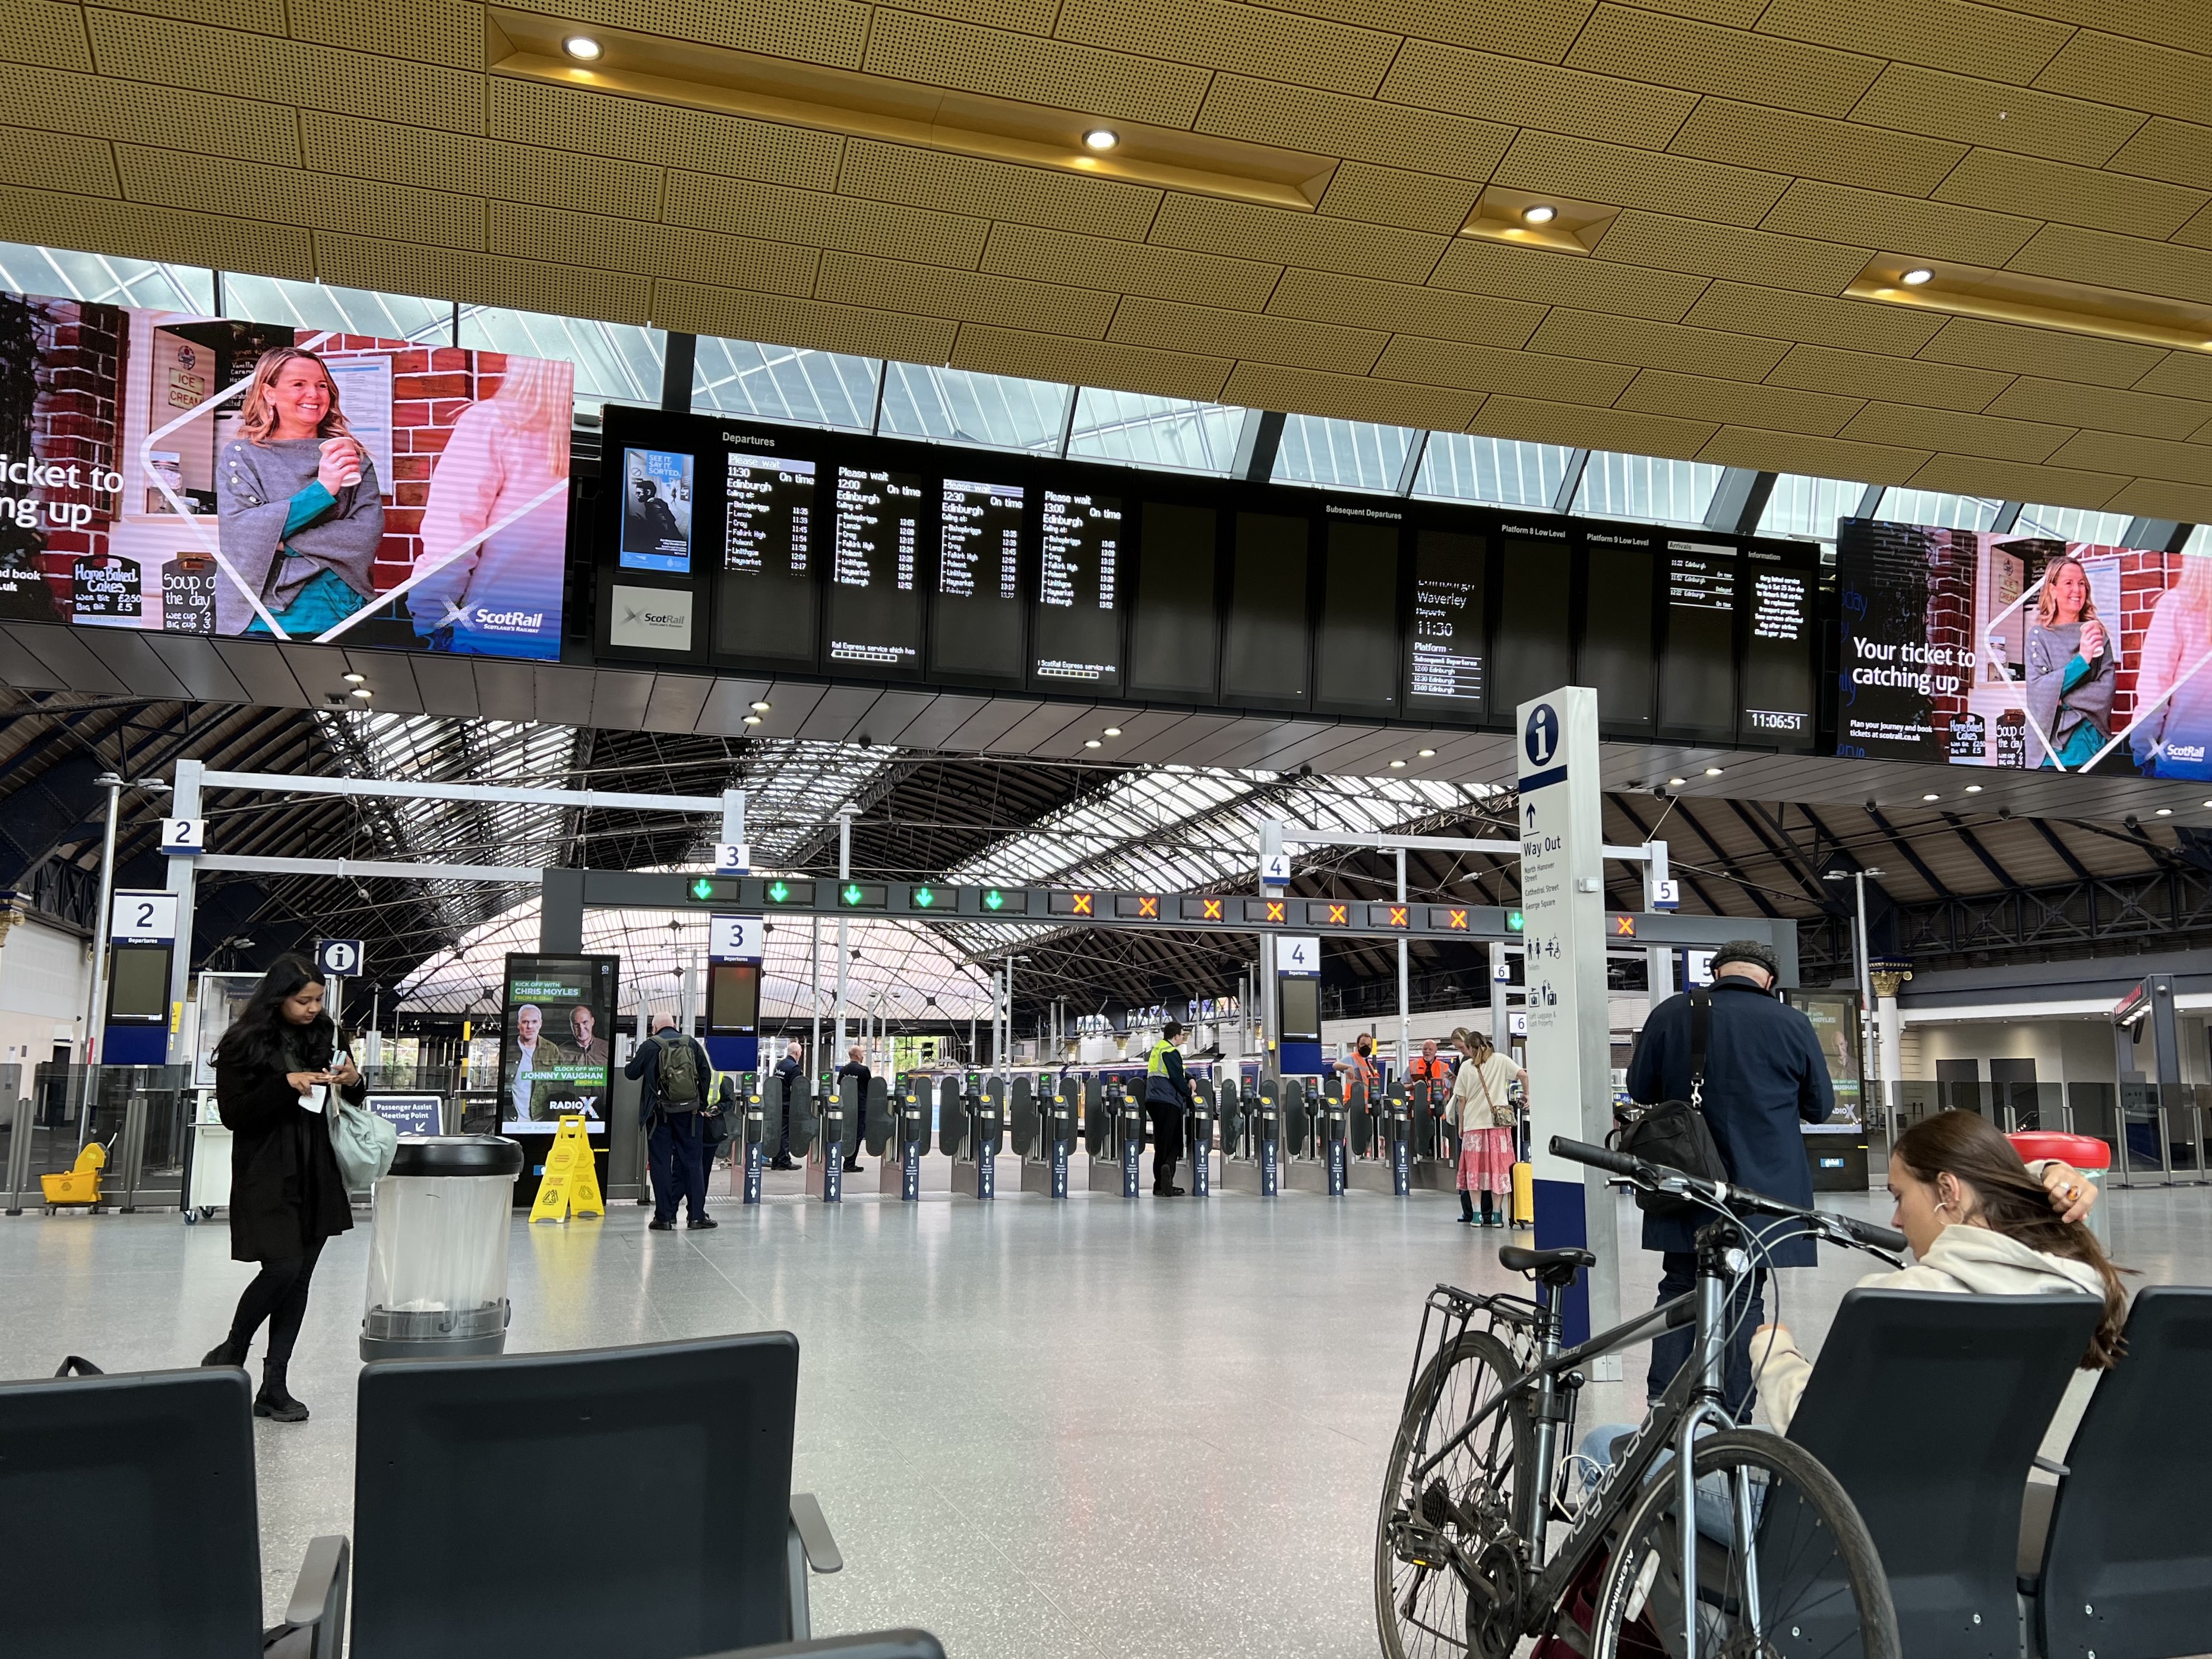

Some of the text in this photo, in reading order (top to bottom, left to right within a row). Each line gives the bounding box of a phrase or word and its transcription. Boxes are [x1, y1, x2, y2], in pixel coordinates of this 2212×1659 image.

[179, 374, 195, 387] ICE
[722, 432, 775, 447] Departures
[729, 454, 780, 469] Please wait
[90, 467, 124, 493] to
[728, 467, 815, 485] 11:30 On time
[839, 466, 889, 481] Please wait
[727, 478, 772, 492] Edinburgh
[838, 479, 921, 497] 12:00 On time
[943, 479, 992, 494] Please wait
[836, 490, 880, 504] Edinburgh
[943, 491, 1023, 509] 12:30 On time
[1045, 491, 1091, 505] Please wait
[49, 501, 92, 532] up
[942, 502, 984, 517] Edinburgh
[1044, 503, 1121, 520] 13:00 On time
[1326, 505, 1402, 519] Subsequent Departures
[1043, 513, 1083, 527] Edinburgh
[1502, 524, 1528, 534] Platform
[1587, 533, 1613, 542] Platform
[1748, 551, 1781, 560] Information
[12, 570, 41, 580] book
[75, 564, 138, 583] Home Baked
[87, 581, 126, 593] Cakes
[162, 573, 201, 595] Soup
[166, 591, 211, 614] the day
[1417, 591, 1467, 608] Waverley
[204, 612, 211, 621] 2
[476, 609, 543, 627] ScotRail
[644, 614, 684, 624] ScotRail
[203, 621, 211, 629] 3
[1418, 621, 1453, 636] 11:30
[1414, 642, 1446, 652] Platform
[1853, 637, 1976, 668] Your ticket to
[1853, 665, 1960, 697] catching up
[1752, 713, 1800, 729] 11:06:51
[1850, 720, 1864, 728] Plan
[1865, 722, 1879, 730] your
[1880, 723, 1903, 732] journey
[1917, 725, 1932, 733] book
[1957, 731, 1977, 740] Cakes
[1996, 725, 2017, 740] Soup
[1998, 738, 2023, 754] the day
[2167, 744, 2205, 757] ScotRail
[175, 821, 191, 843] 2
[1524, 835, 1561, 858] Way Out
[726, 846, 740, 867] 3
[1270, 857, 1282, 876] 4
[1524, 874, 1537, 883] Street
[1546, 884, 1559, 892] Street
[1661, 882, 1670, 899] 5
[1541, 899, 1556, 908] Square
[137, 902, 154, 927] 2
[729, 924, 743, 947] 3
[1292, 944, 1304, 964] 4
[1499, 966, 1505, 977] 6
[1518, 1017, 1524, 1029] 6
[377, 1104, 411, 1112] Passenger
[549, 1096, 599, 1119] RADIO X
